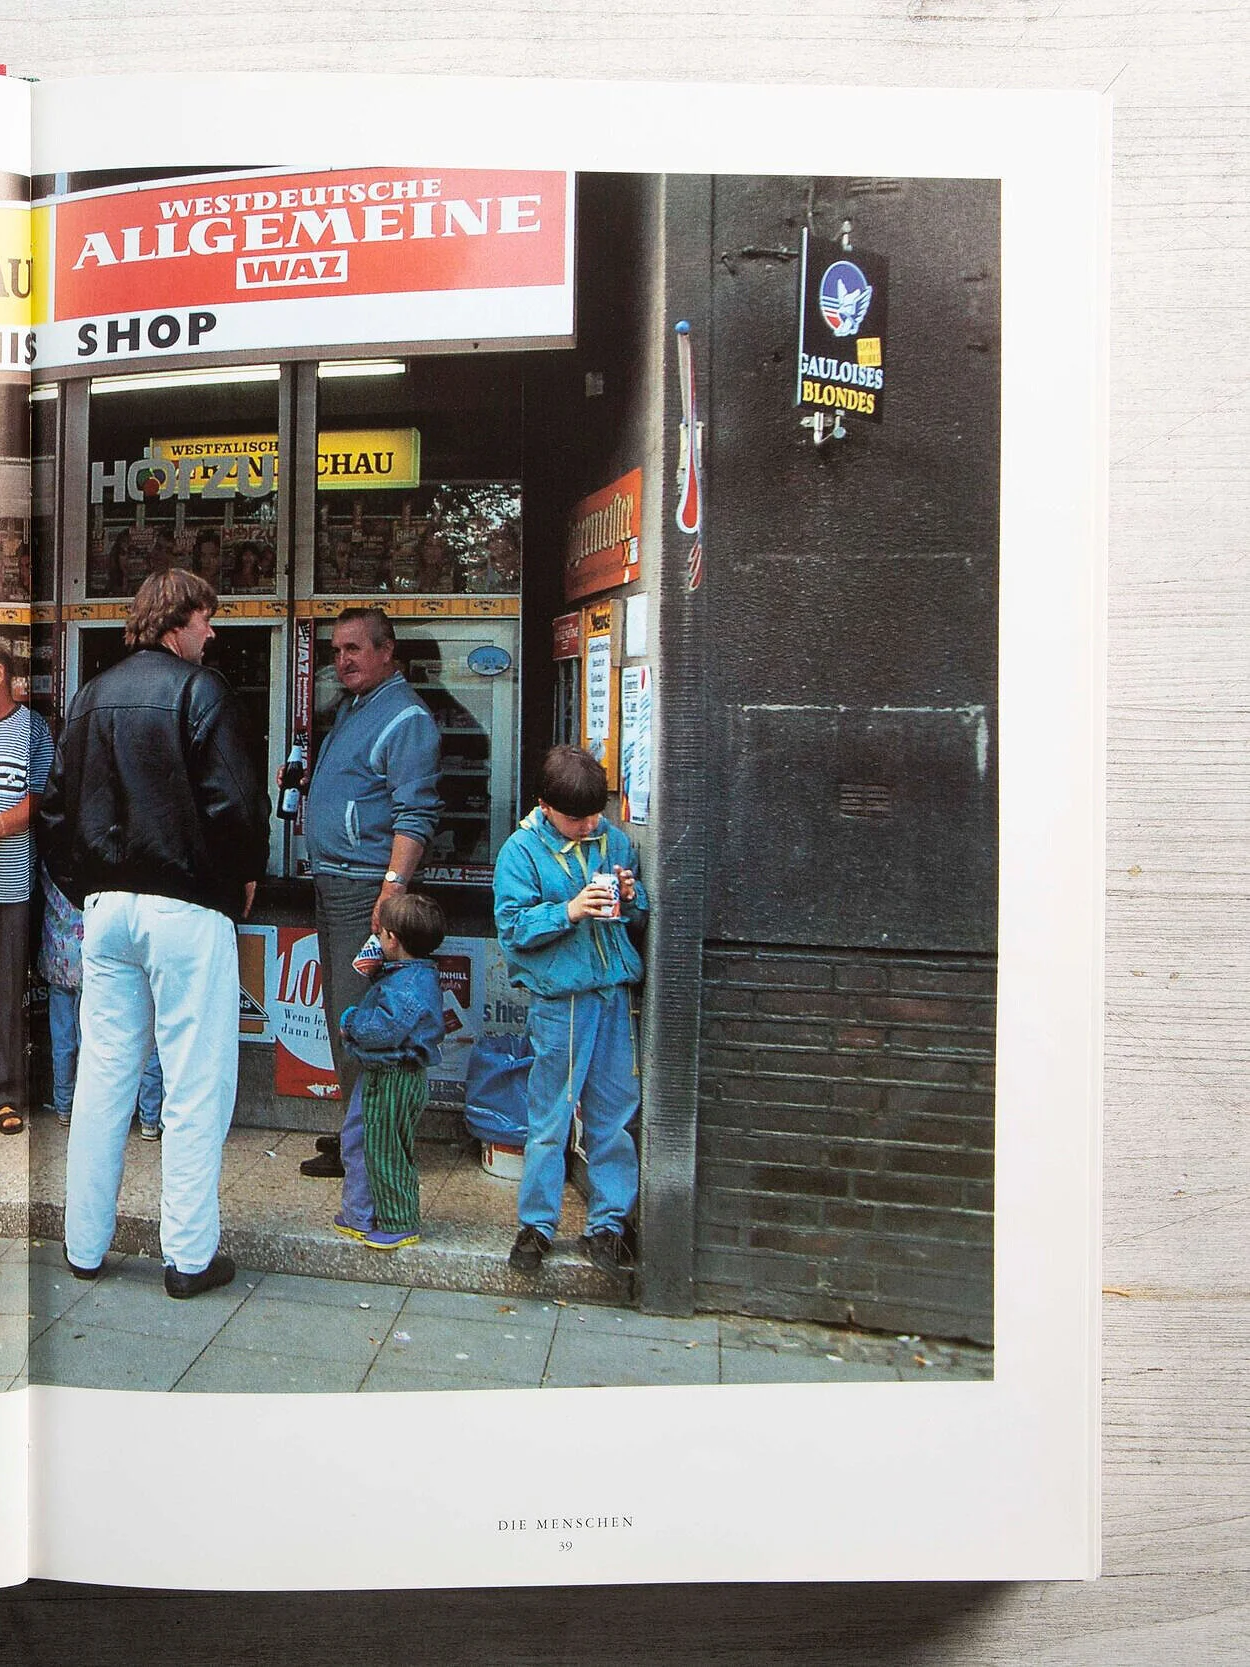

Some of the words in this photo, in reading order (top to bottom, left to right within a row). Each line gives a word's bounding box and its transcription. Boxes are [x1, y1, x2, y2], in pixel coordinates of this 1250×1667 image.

[159, 178, 442, 219] WESTDEUTSCHE
[72, 194, 541, 271] ALLGEMEINE
[242, 254, 343, 284] WAZ
[77, 311, 217, 356] SHOP
[799, 352, 884, 390] GAULOISES
[802, 380, 875, 414] BLONDES
[171, 441, 279, 457] WESTFÄLISCH
[281, 1023, 309, 1037] dann
[284, 1008, 310, 1024] Wenn
[497, 1520, 527, 1531] DIE
[536, 1516, 634, 1530] MENSCHEN
[558, 1540, 573, 1552] 39
